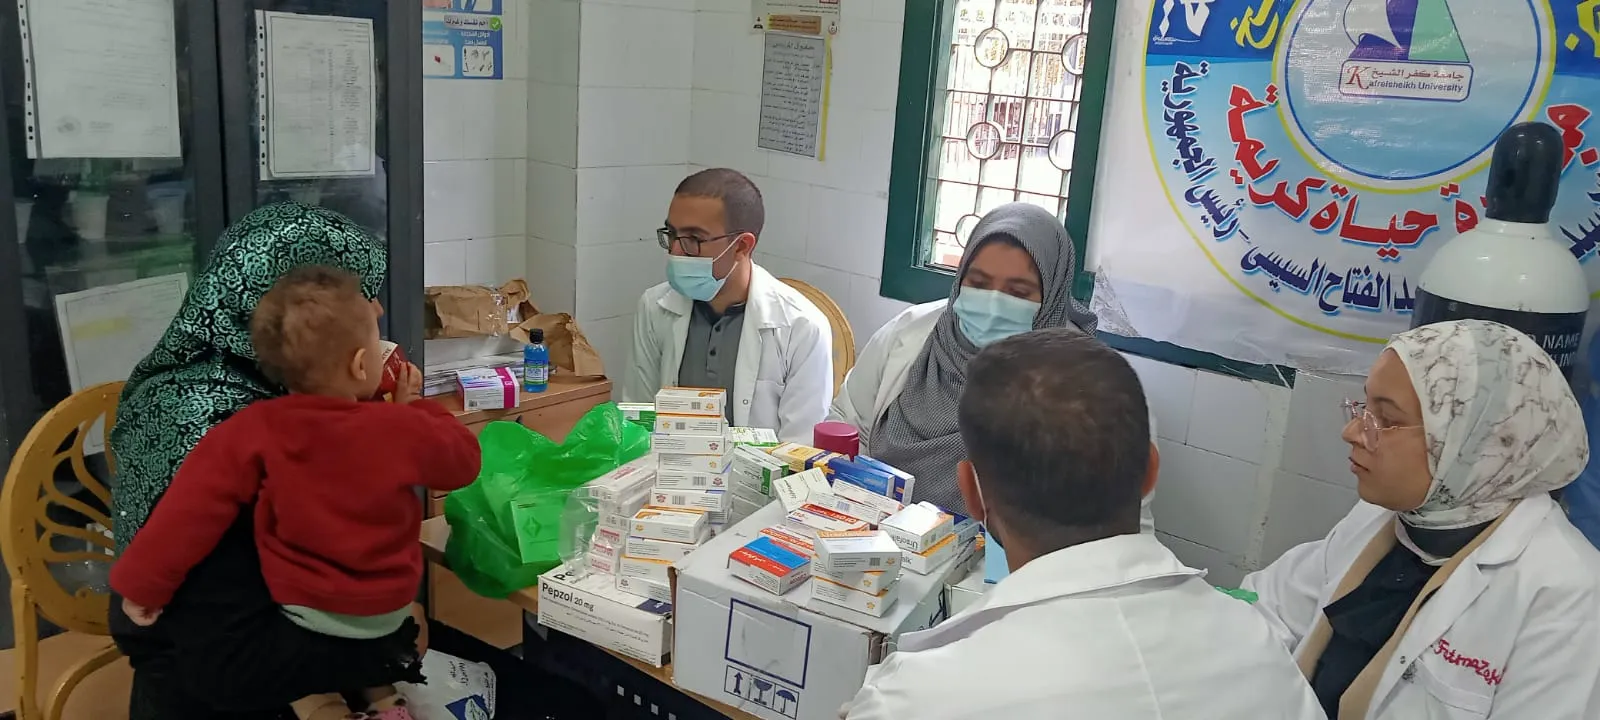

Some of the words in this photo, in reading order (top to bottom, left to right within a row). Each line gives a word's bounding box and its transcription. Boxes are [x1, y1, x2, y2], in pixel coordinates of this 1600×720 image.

[1371, 67, 1404, 79] الشيخ
[1406, 68, 1431, 79] كفر
[1419, 80, 1464, 93] University
[1433, 70, 1465, 81] جامعة
[1161, 61, 1218, 182] الجمهورية
[1227, 83, 1328, 220] كريمة
[1184, 184, 1245, 238] رئيس
[1309, 183, 1439, 259] حياة
[1318, 264, 1392, 313] الفتاح
[541, 582, 574, 602] Pepzol
[574, 596, 583, 607] 20
[583, 602, 595, 612] mg
